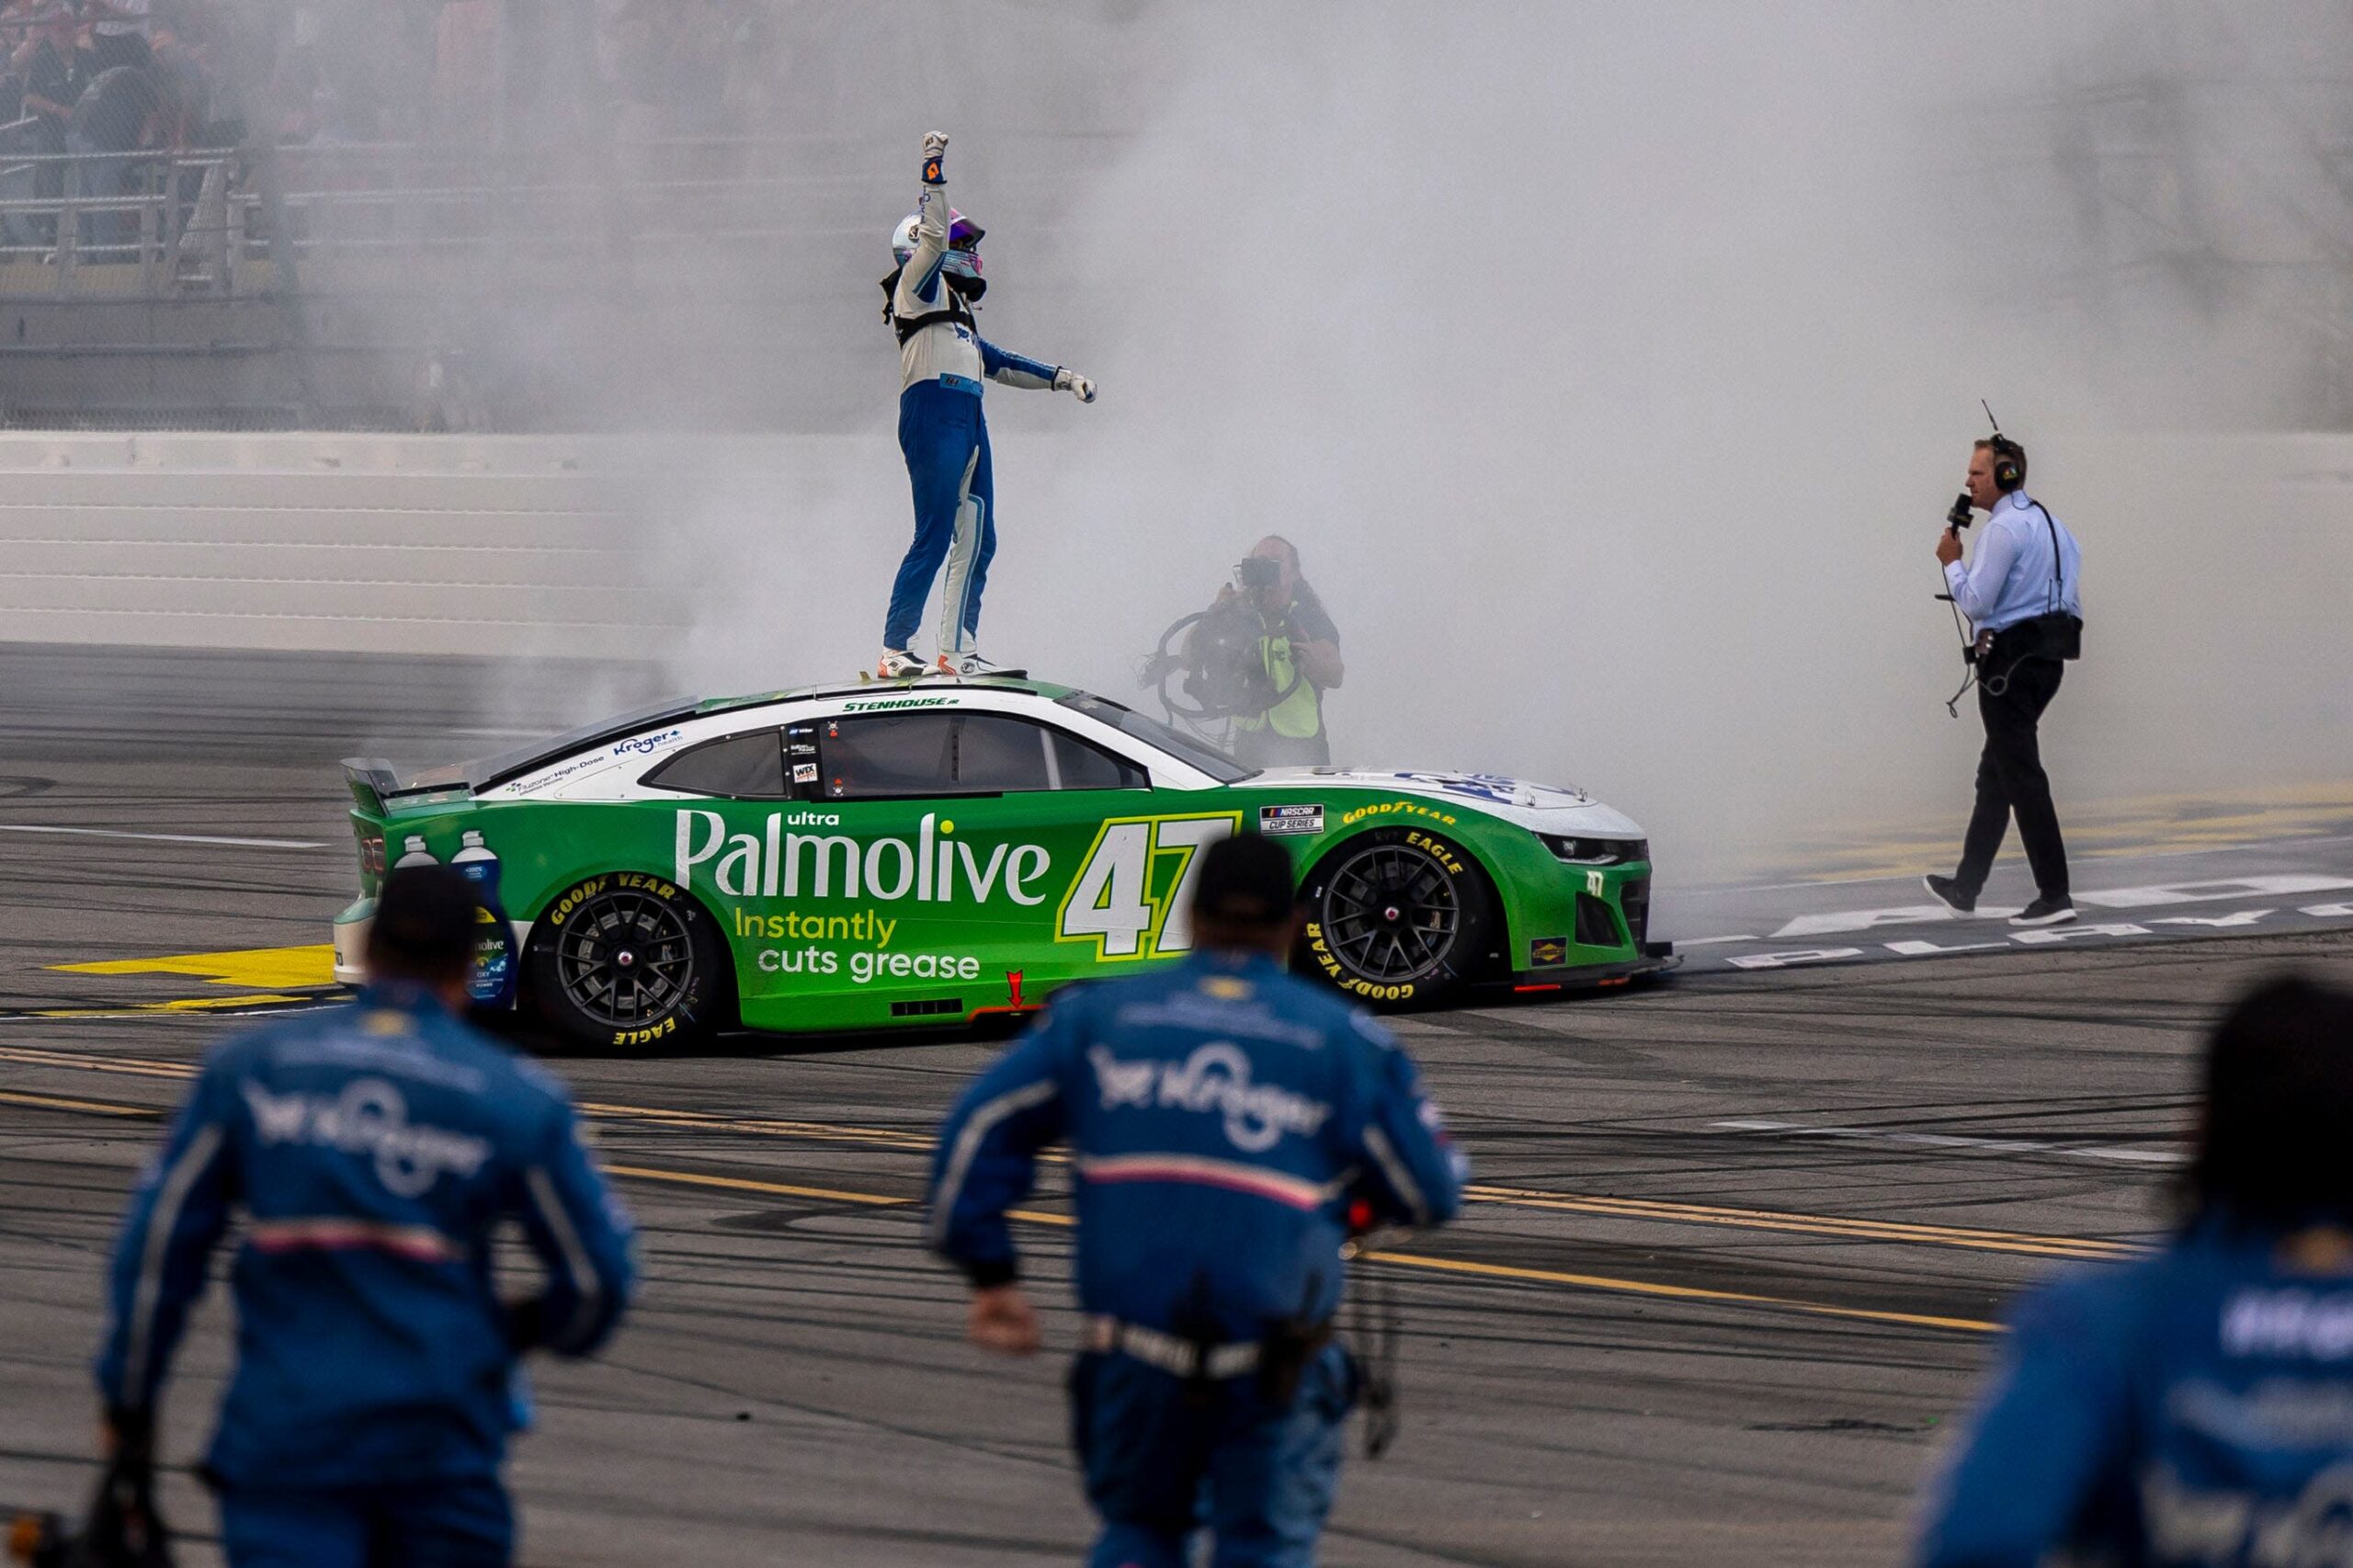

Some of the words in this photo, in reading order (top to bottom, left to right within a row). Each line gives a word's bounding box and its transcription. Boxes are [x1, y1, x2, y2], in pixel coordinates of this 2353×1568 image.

[843, 697, 947, 711] STENHOUSE
[613, 733, 668, 756] Kroger
[553, 756, 605, 778] High-Dose
[788, 812, 839, 826] ultra
[1269, 820, 1286, 829] CUP
[1287, 819, 1315, 828] SERIES
[1280, 807, 1314, 816] NASCAR
[676, 809, 1051, 905] Palmolive
[1406, 831, 1463, 874] EAGLE
[1054, 811, 1243, 962] 47
[735, 906, 897, 949] Instantly
[757, 946, 838, 973] cuts
[849, 950, 980, 983] grease
[613, 1017, 676, 1045] EAGLE
